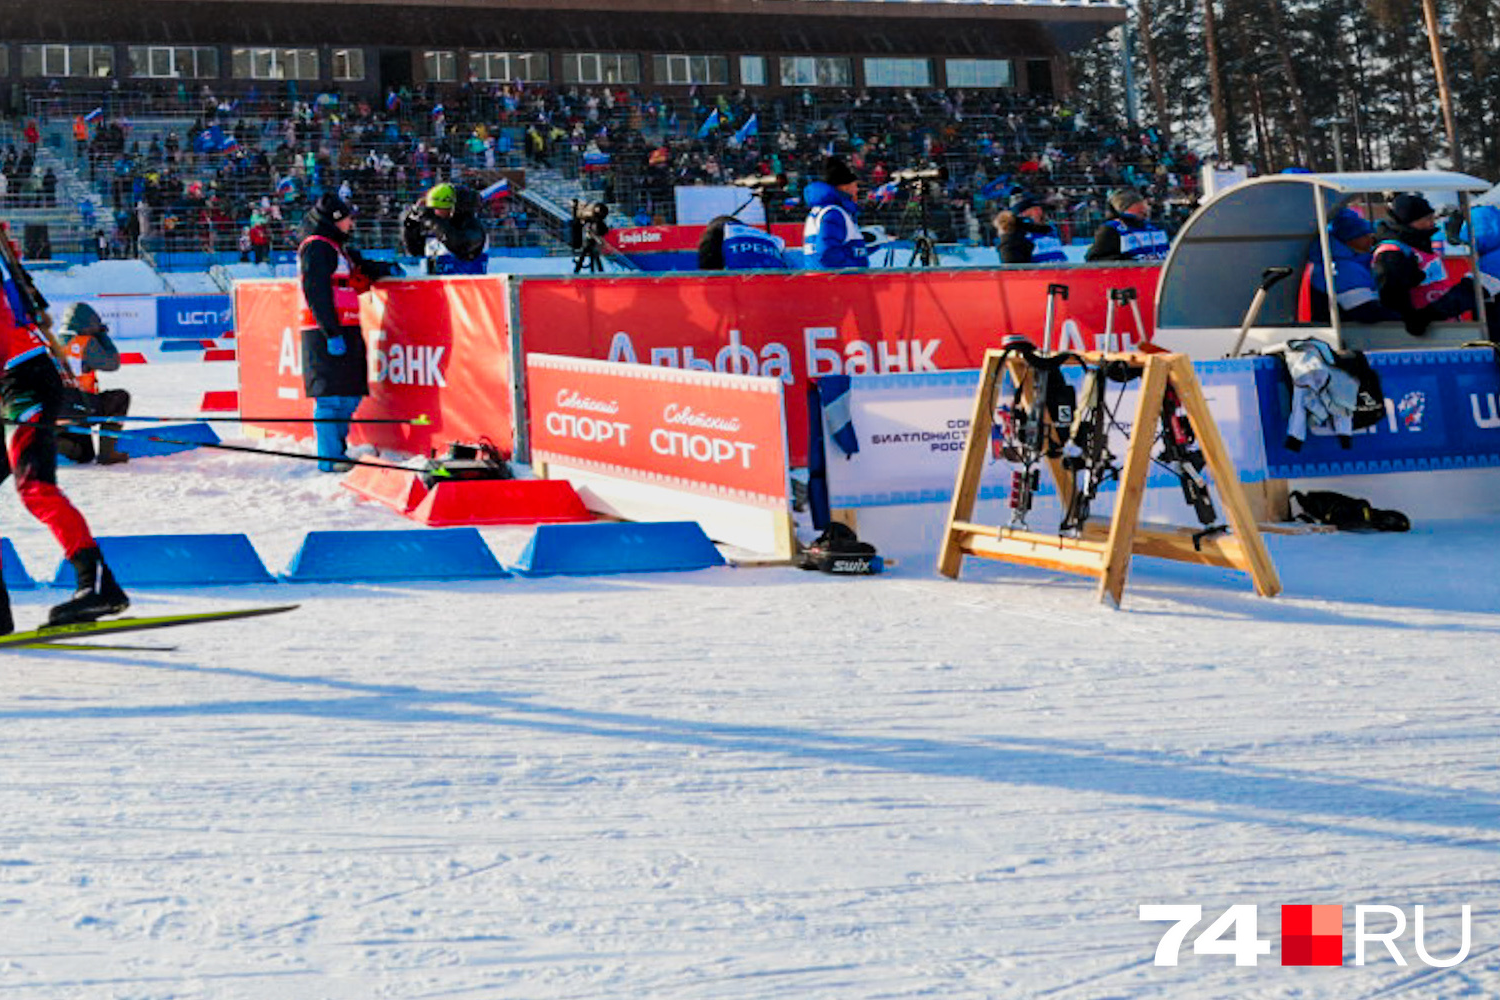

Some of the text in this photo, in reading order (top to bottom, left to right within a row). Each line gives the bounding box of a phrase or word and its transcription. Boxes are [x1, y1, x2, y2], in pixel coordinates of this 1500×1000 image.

[369, 330, 447, 387] Банк
[804, 327, 942, 377] Банк
[557, 388, 619, 414] Советский
[663, 403, 741, 432] Советский
[546, 412, 631, 447] СПОРТ
[872, 431, 968, 444] БИАТЛОНИСТ
[650, 428, 756, 469] СПОРТ
